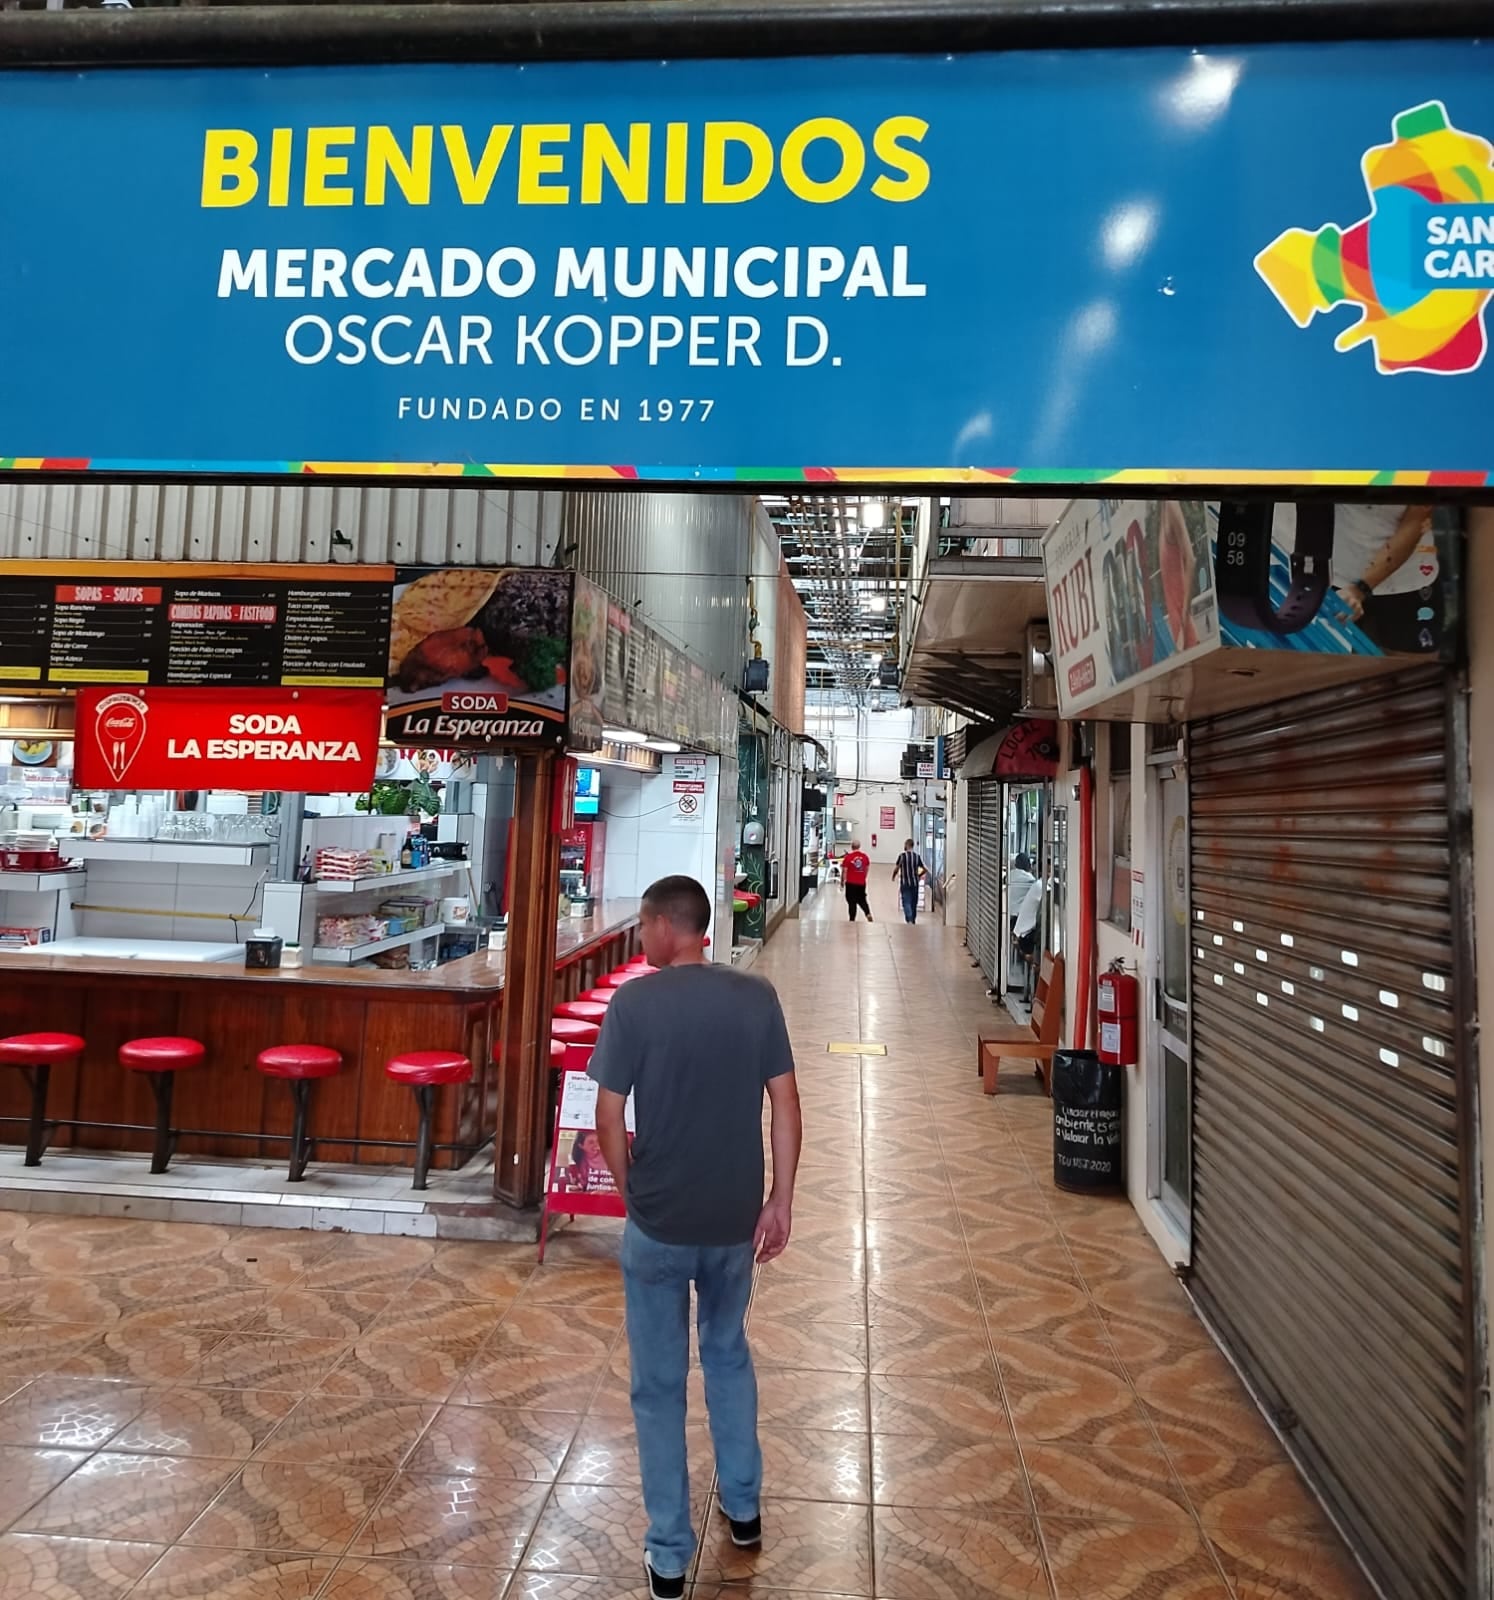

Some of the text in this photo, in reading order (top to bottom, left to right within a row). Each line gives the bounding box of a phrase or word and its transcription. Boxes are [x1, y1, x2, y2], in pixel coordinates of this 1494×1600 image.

[200, 115, 931, 208] BIENVENIDOS
[1426, 215, 1494, 245] SAN
[217, 245, 927, 298] MERCADO MUNICIPAL
[285, 314, 842, 366] OSCAR KOPPER D.
[398, 397, 714, 422] FUNDADO EN 1977
[1227, 532, 1246, 548] 09
[1226, 550, 1245, 566] 58
[74, 586, 102, 601] SOPAS
[113, 587, 144, 602] SOUPS
[171, 604, 201, 620] COMIDAS
[239, 606, 274, 620] FASTFOOD
[451, 696, 498, 710] SODA
[228, 714, 302, 734] SODA
[403, 714, 430, 734] La
[434, 714, 544, 741] Esperanza
[168, 738, 362, 762] LA ESPERANZA
[1000, 720, 1041, 760] LOCAL
[1056, 1114, 1096, 1132] ambiente
[1097, 1122, 1108, 1133] es
[1090, 1160, 1112, 1173] 2020
